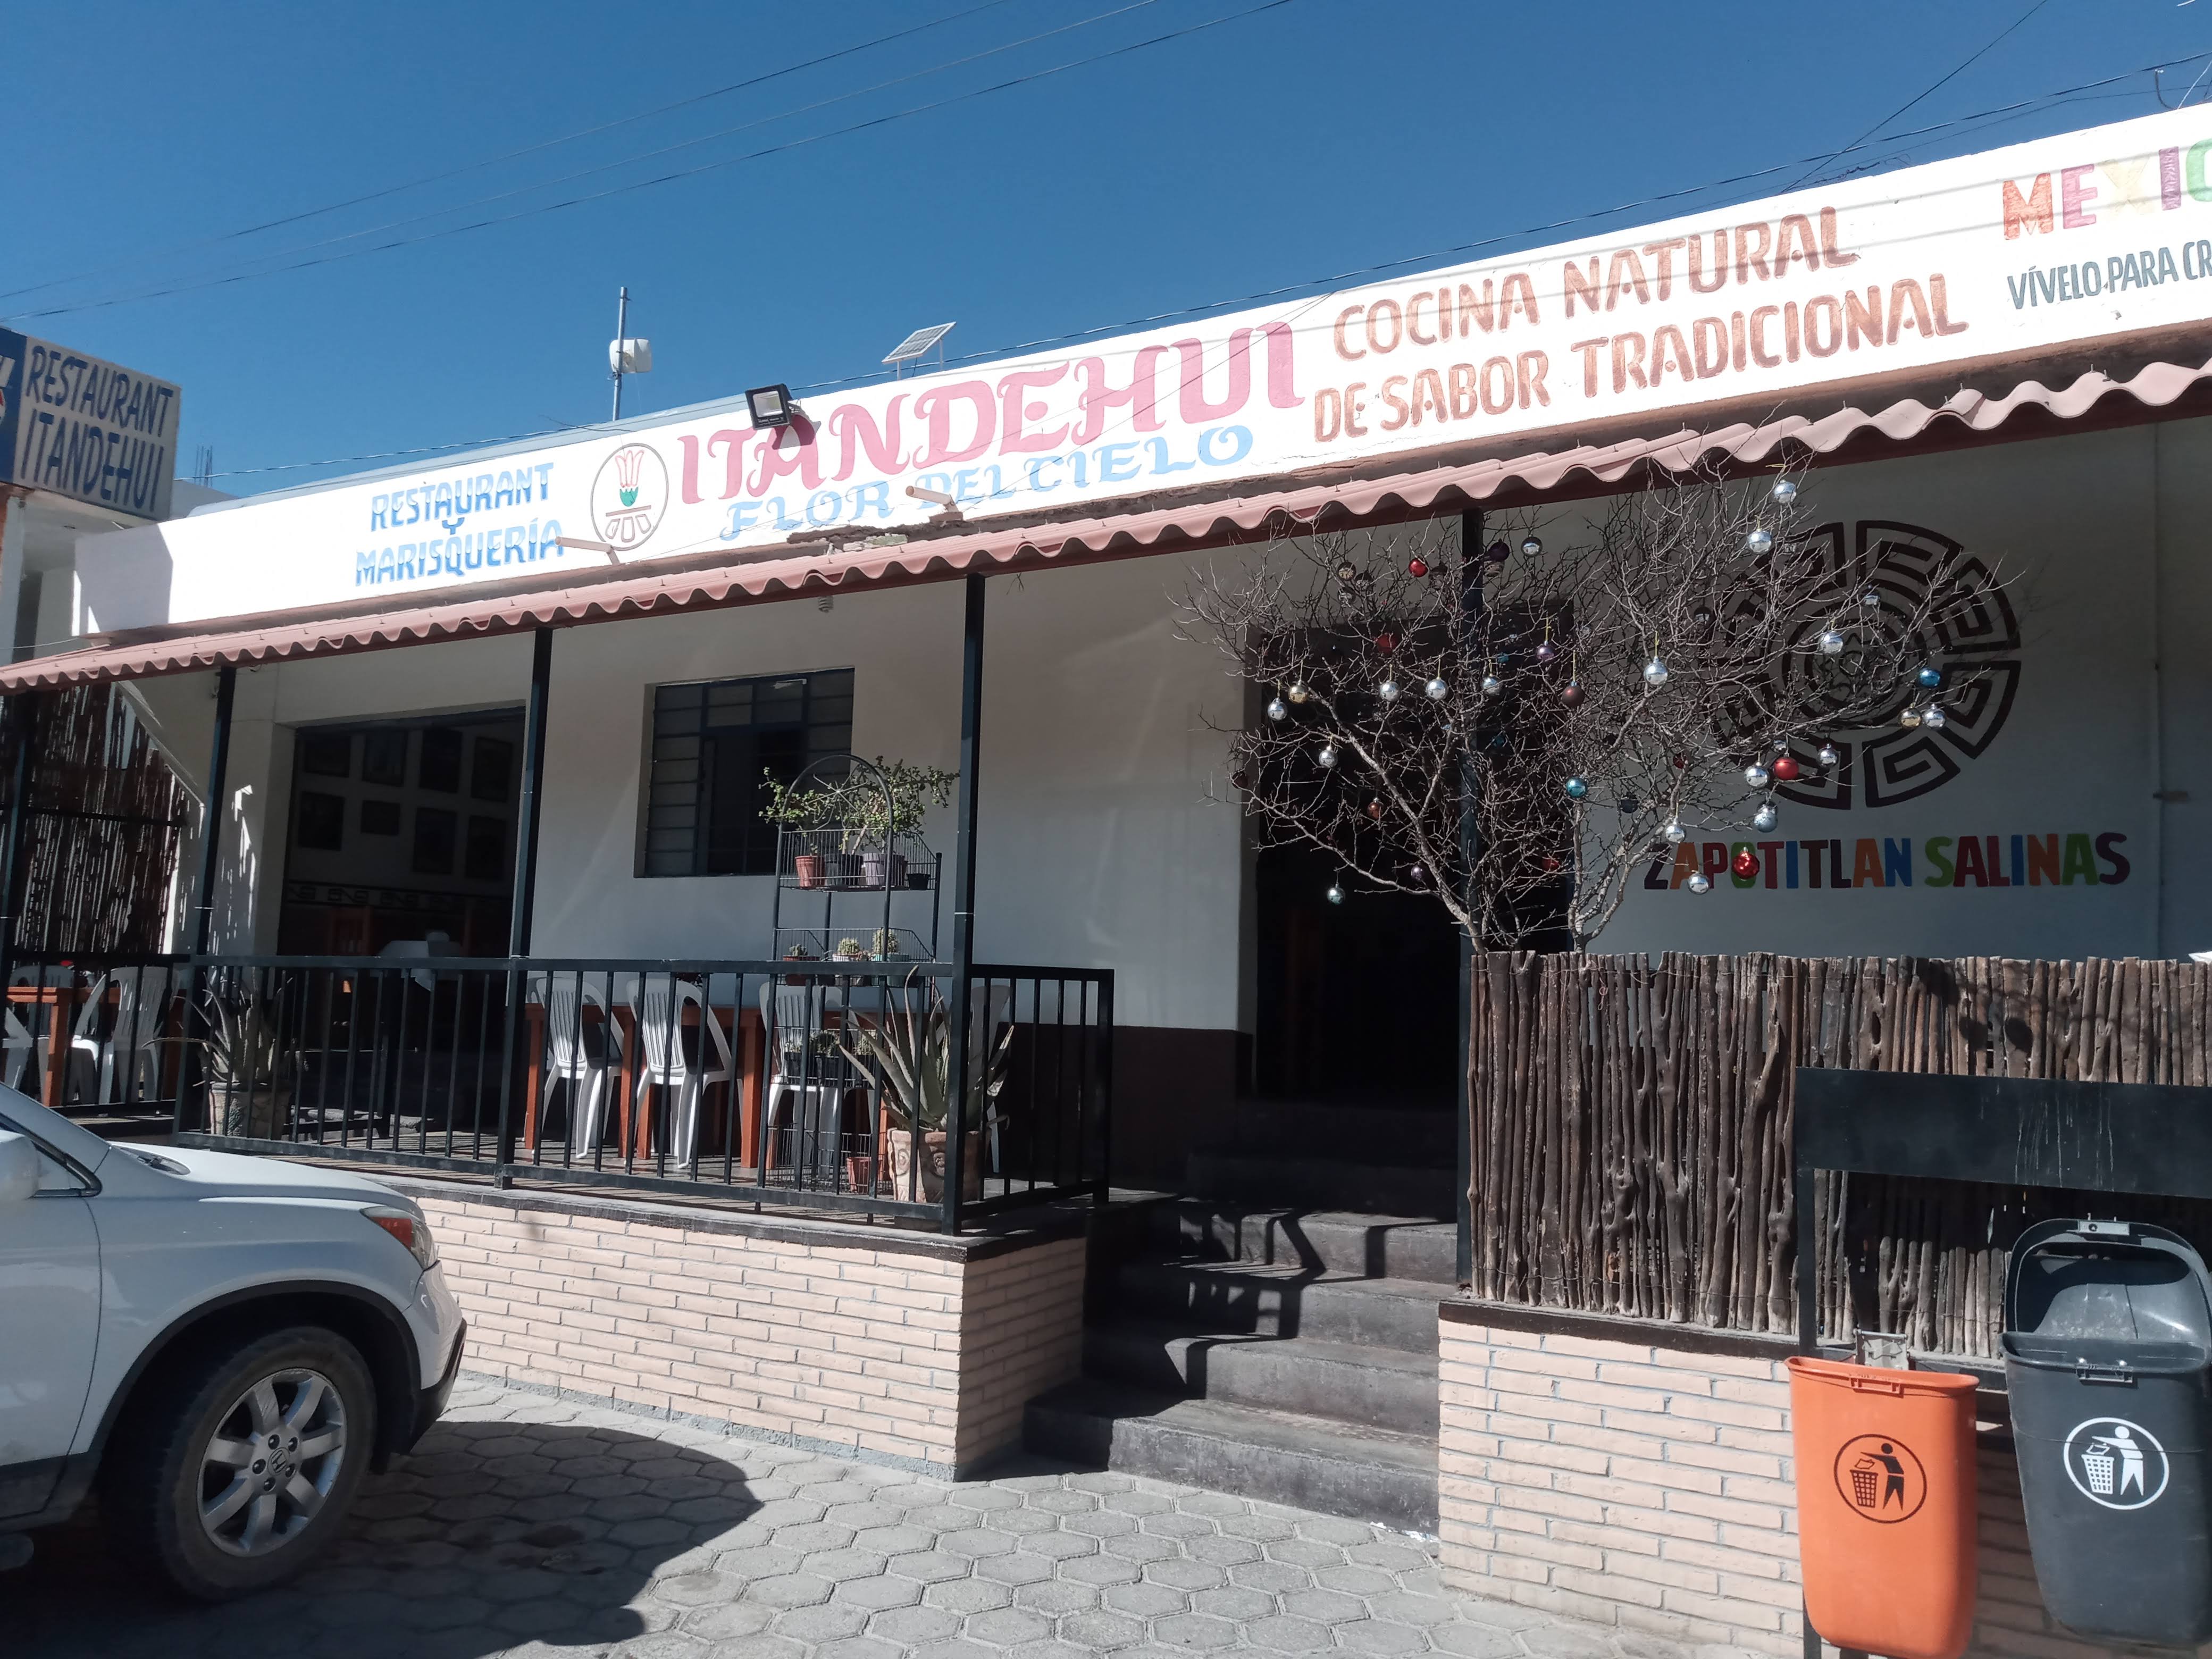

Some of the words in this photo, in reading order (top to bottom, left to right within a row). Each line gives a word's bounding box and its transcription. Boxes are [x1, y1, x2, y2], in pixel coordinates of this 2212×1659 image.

[1334, 272, 1541, 361] COCINA
[1564, 206, 1859, 319] NATURAL
[2107, 247, 2179, 293] PARA
[26, 346, 173, 437] RESTAURANT
[1314, 382, 1369, 442] DE
[1380, 350, 1551, 431] SABOR
[1571, 273, 1969, 398] TRADICIONAL
[677, 322, 1306, 504] ITANDEHUI
[21, 409, 164, 512] ITANDEHUI
[371, 462, 554, 532] RESTAURANT
[719, 480, 893, 541] FLOR
[915, 464, 1017, 509] DEL
[1024, 425, 1253, 492] CIELO
[355, 518, 564, 586] MARISQUERÍA
[442, 517, 465, 535] Y
[1925, 833, 2130, 886] SALINAS
